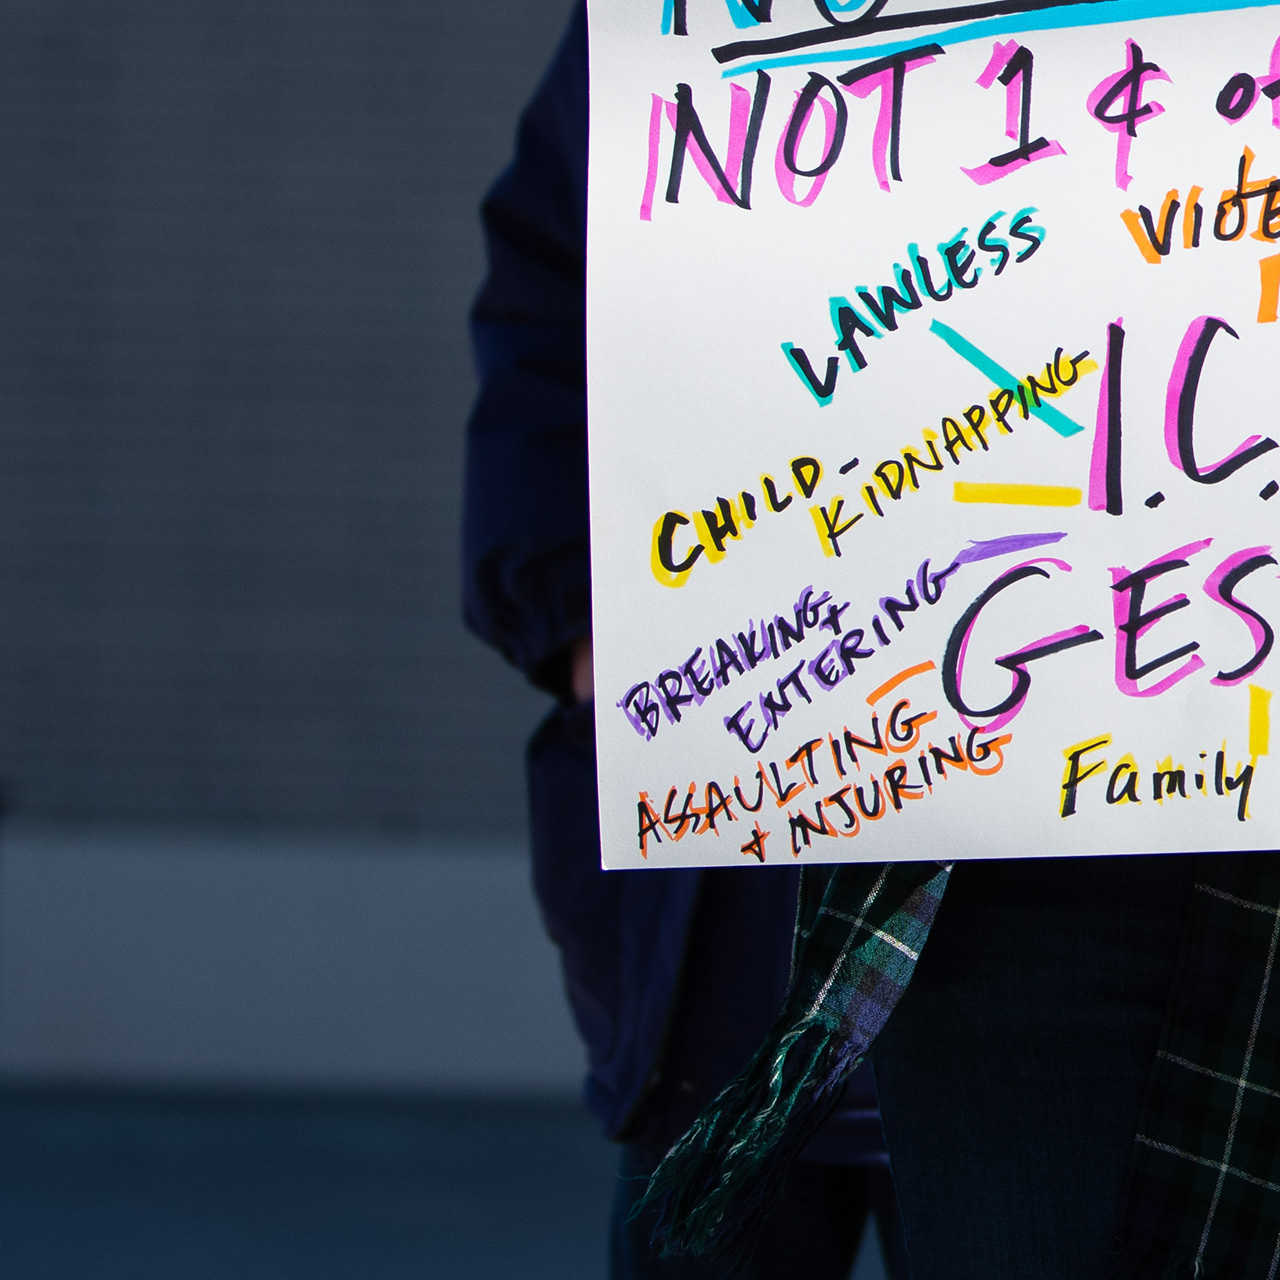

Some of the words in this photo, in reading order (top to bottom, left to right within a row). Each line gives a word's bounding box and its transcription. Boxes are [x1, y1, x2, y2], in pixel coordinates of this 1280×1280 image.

[639, 43, 947, 222] NOT
[959, 37, 1068, 187] 1
[780, 206, 1047, 407] LAWLESS
[650, 455, 860, 589] CHILD-
[812, 346, 1099, 558] KIDNAPPING
[617, 585, 832, 741] BREAKING
[723, 558, 961, 754] ENTERING
[637, 698, 938, 860] ASSAULTING
[788, 726, 1014, 858] INJURING
[1059, 732, 1258, 821] Family
